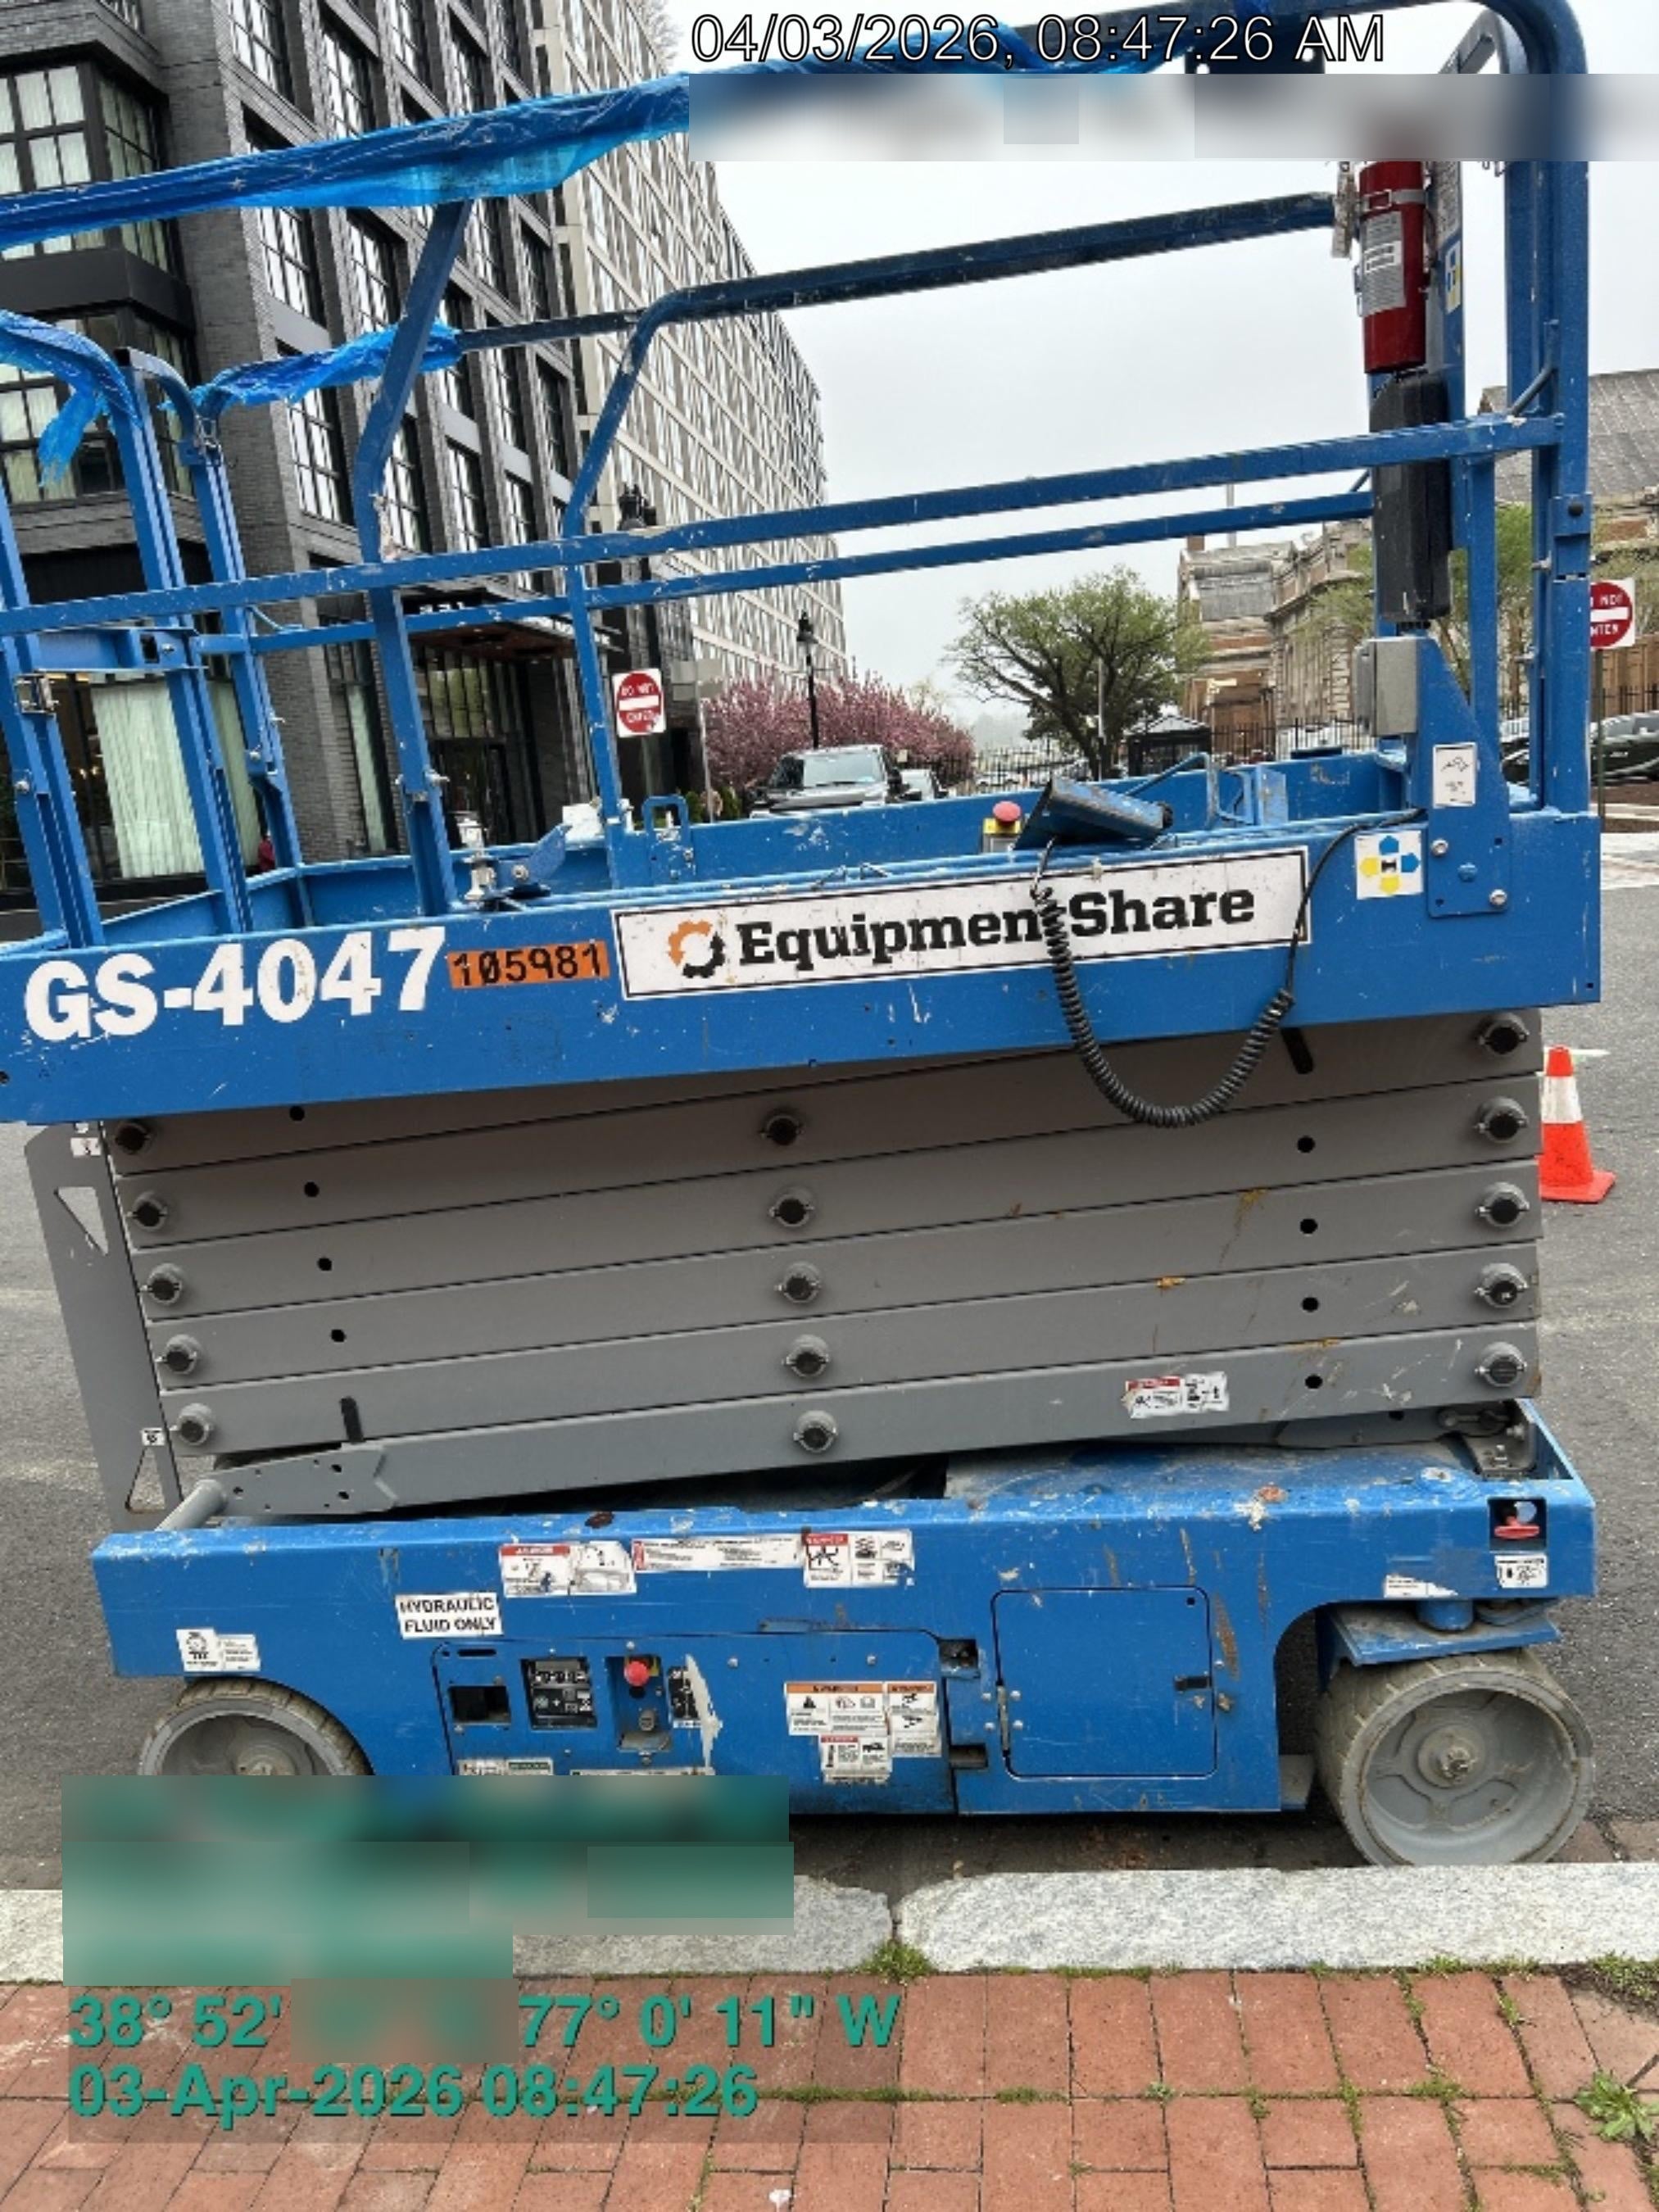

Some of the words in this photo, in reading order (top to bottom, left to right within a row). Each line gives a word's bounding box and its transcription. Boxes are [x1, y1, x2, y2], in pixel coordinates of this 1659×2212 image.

[736, 888, 1255, 971] EquipmenShare
[24, 926, 446, 1041] GS-4047
[453, 943, 601, 986] 105981
[400, 1597, 495, 1613] HYDRAULIC
[405, 1618, 451, 1633] FLUID
[454, 1616, 496, 1631] ONLY
